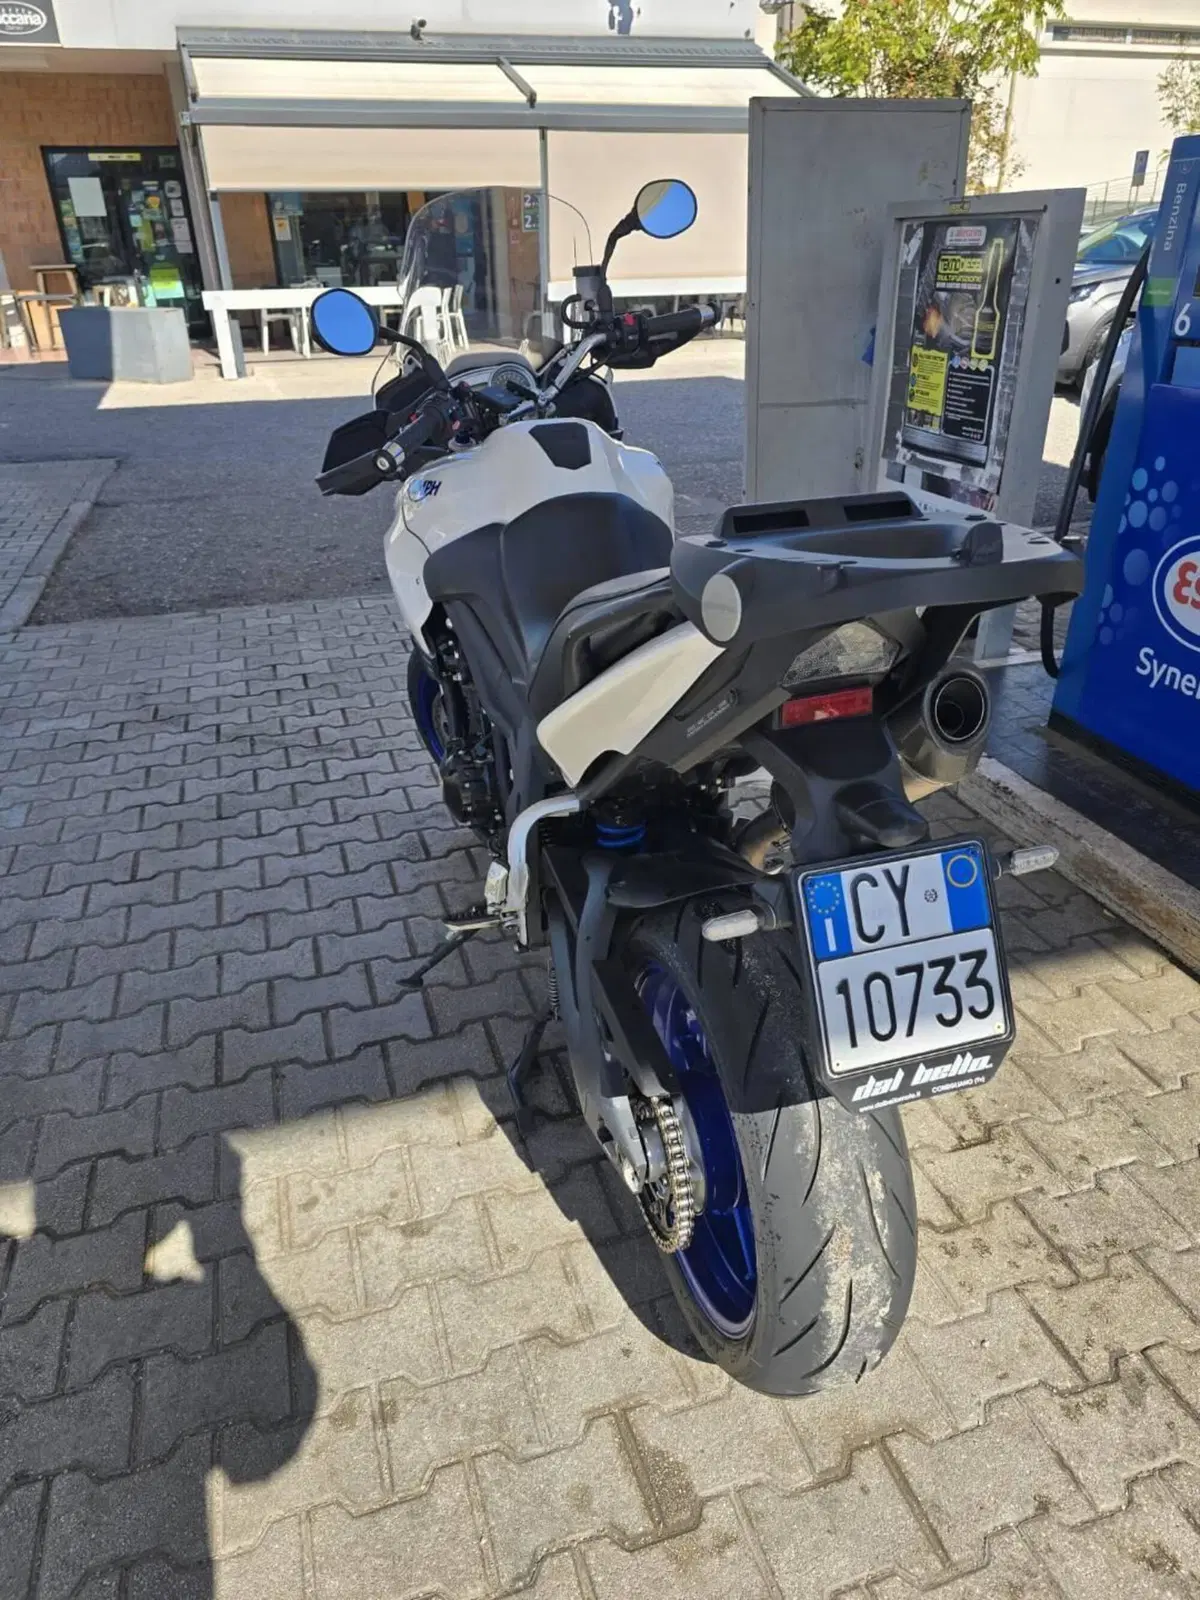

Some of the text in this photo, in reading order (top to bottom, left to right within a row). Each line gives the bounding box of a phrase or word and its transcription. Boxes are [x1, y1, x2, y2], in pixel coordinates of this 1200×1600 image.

[1164, 183, 1187, 251] Benzina
[1174, 303, 1192, 336] 6
[850, 864, 910, 944] CY
[836, 949, 995, 1049] 10733
[852, 1067, 905, 1102] dal
